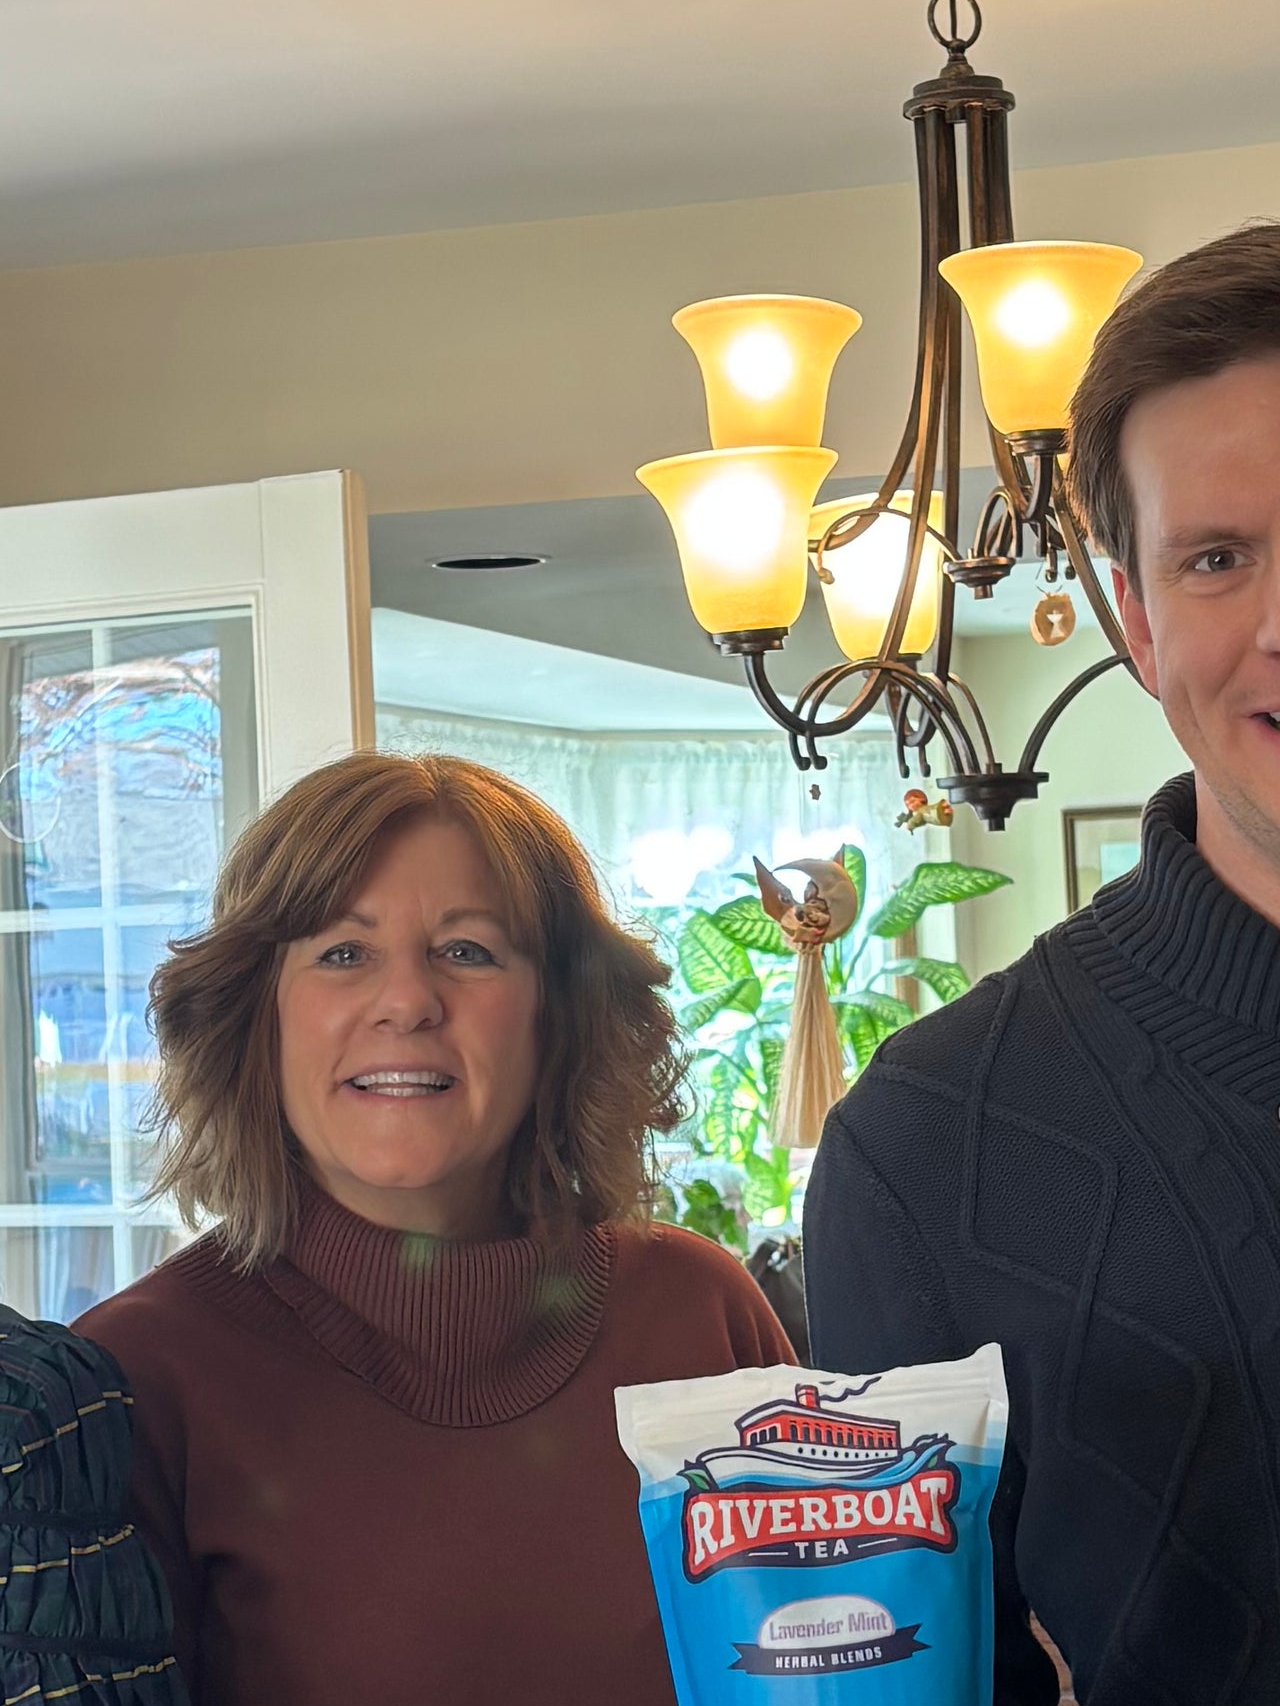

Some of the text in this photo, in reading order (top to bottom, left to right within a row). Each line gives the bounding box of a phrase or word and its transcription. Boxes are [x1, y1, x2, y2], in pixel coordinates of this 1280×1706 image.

[690, 1477, 948, 1566] RIVERBOAT
[794, 1538, 849, 1559] TEA
[769, 1612, 888, 1641] Lavender Mint
[775, 1646, 883, 1669] HERBAL BLENDS
